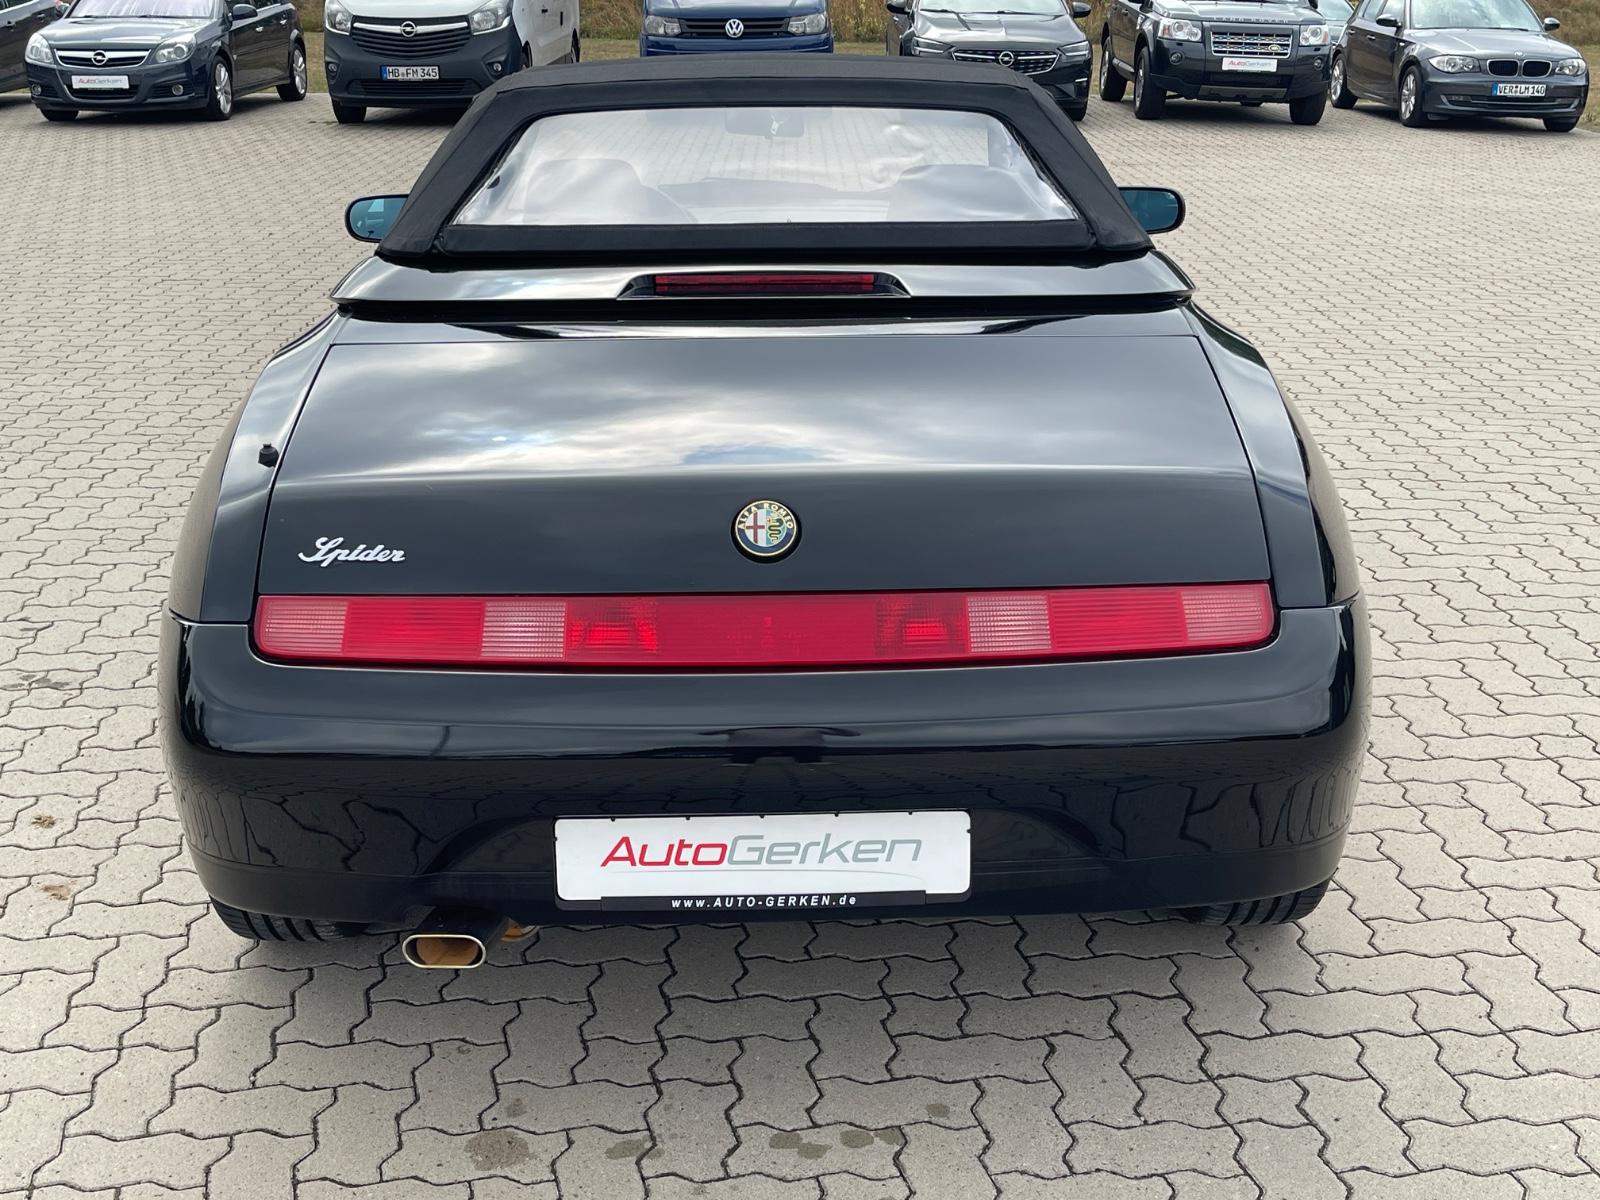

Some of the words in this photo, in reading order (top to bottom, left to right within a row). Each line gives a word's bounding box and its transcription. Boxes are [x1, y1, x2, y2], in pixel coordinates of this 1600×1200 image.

[388, 68, 400, 78] HB
[420, 68, 438, 78] 345
[1498, 85, 1514, 94] VER
[738, 505, 758, 529] ALFA
[763, 502, 794, 529] ROMEO
[298, 536, 406, 568] Spider
[600, 832, 922, 867] AutoGerken
[671, 894, 857, 909] www.AUTO-GERKEN.de
